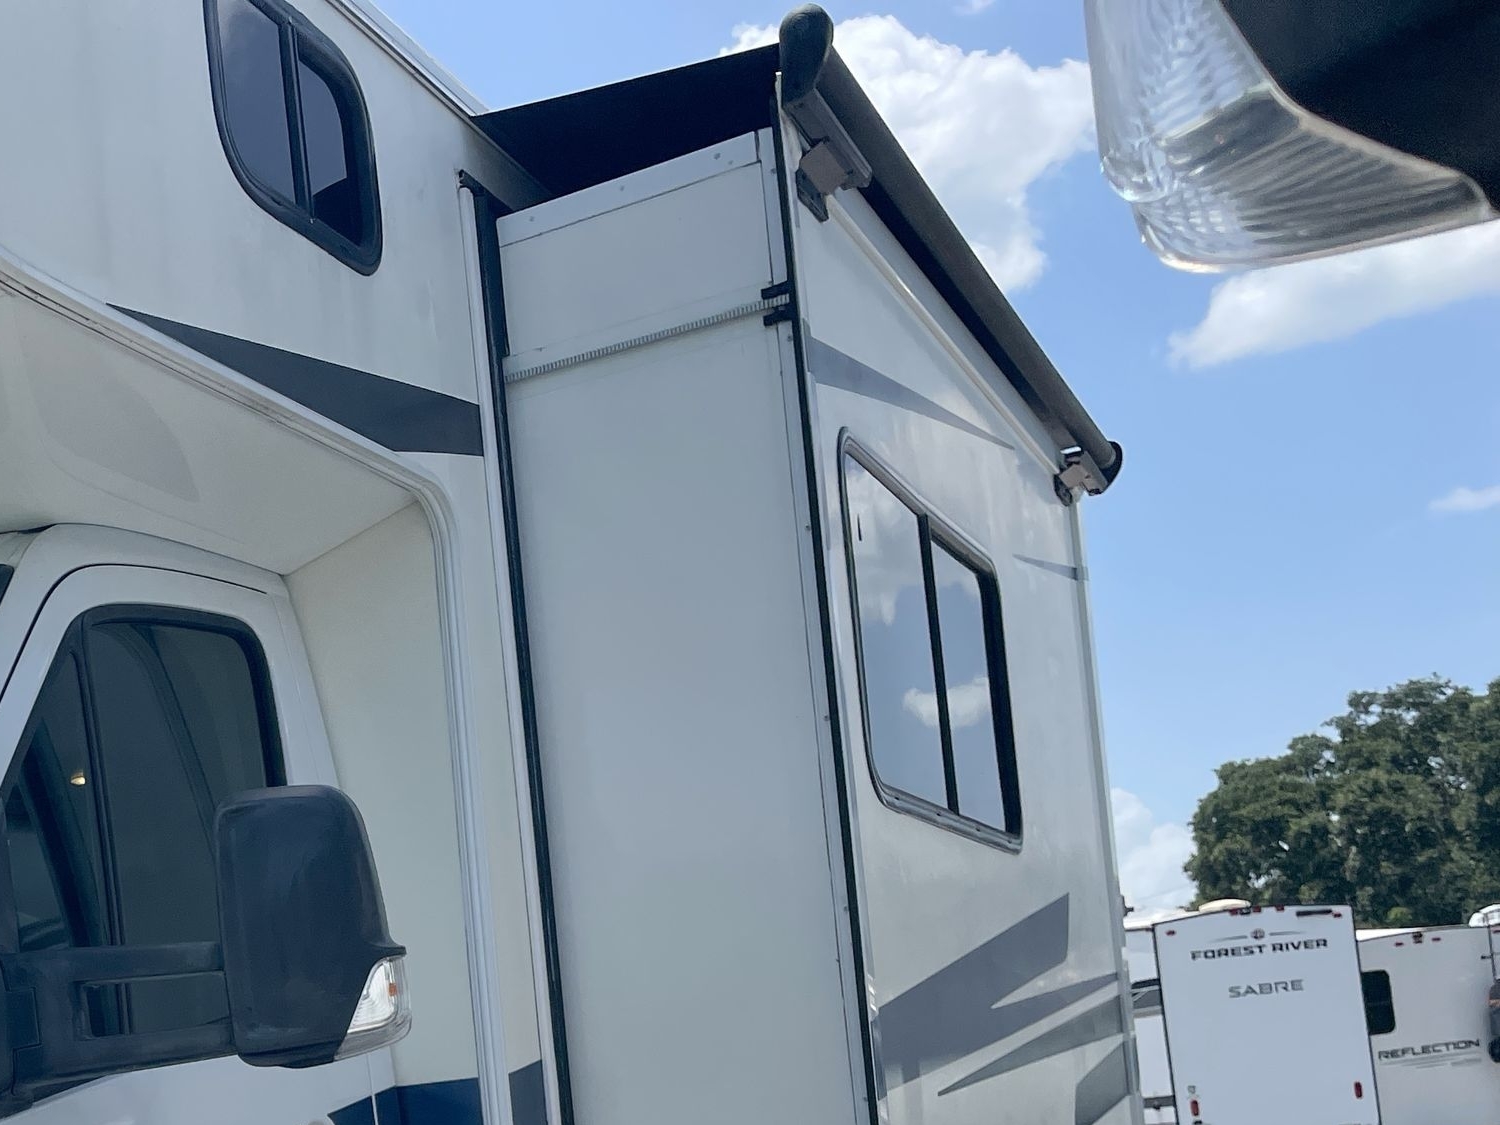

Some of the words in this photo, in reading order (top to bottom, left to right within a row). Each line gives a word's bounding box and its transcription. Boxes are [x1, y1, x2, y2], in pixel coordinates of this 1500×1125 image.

[1190, 944, 1264, 961] FOREST
[1271, 938, 1328, 954] RIVER
[1228, 979, 1304, 998] SABRE
[1377, 1039, 1481, 1061] REFLECTION
